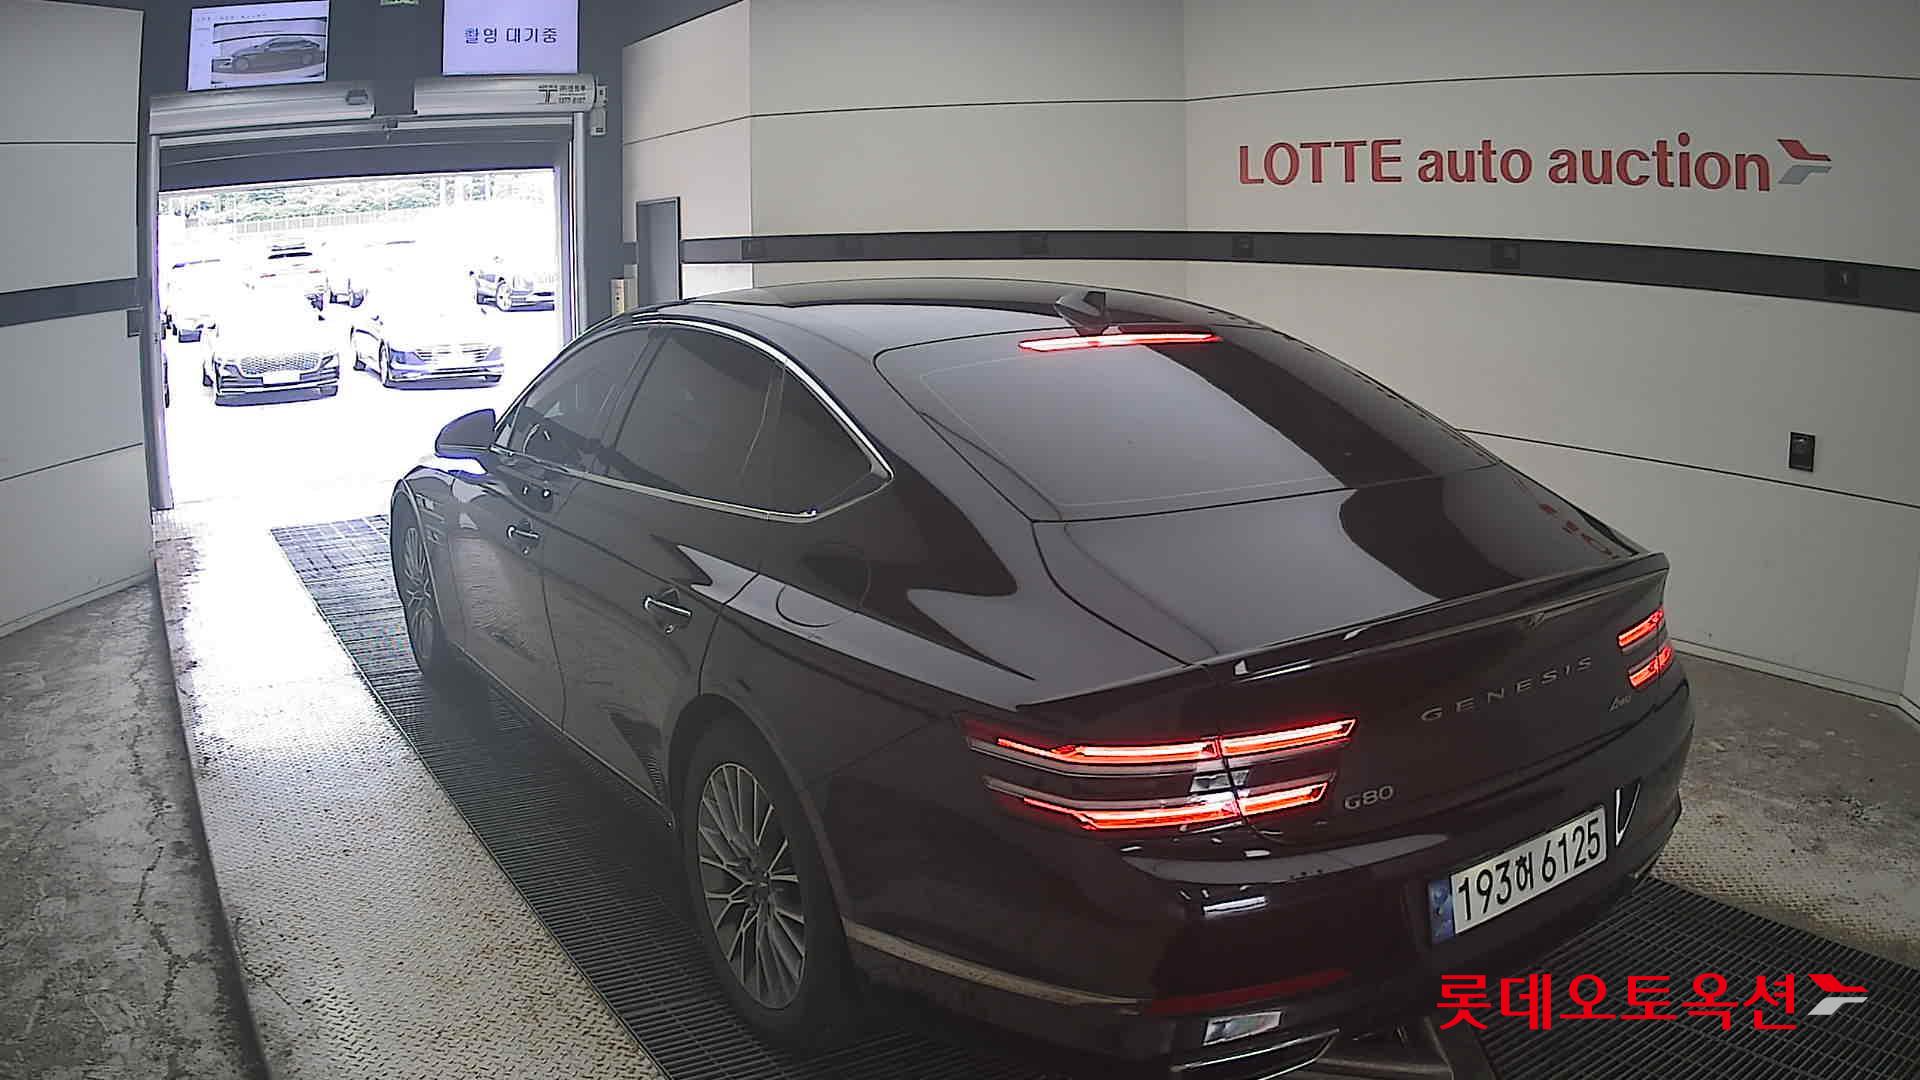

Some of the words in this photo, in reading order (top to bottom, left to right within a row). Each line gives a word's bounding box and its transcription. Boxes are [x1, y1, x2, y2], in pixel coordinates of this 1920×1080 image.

[506, 27, 557, 43] 대기중
[1238, 140, 1402, 187] LOTTE
[1418, 139, 1533, 185] auto
[1548, 133, 1771, 191] auction
[1420, 656, 1593, 722] GENESIS
[1344, 785, 1394, 809] G80
[1458, 851, 1535, 921] 193허
[1541, 818, 1601, 882] 6125
